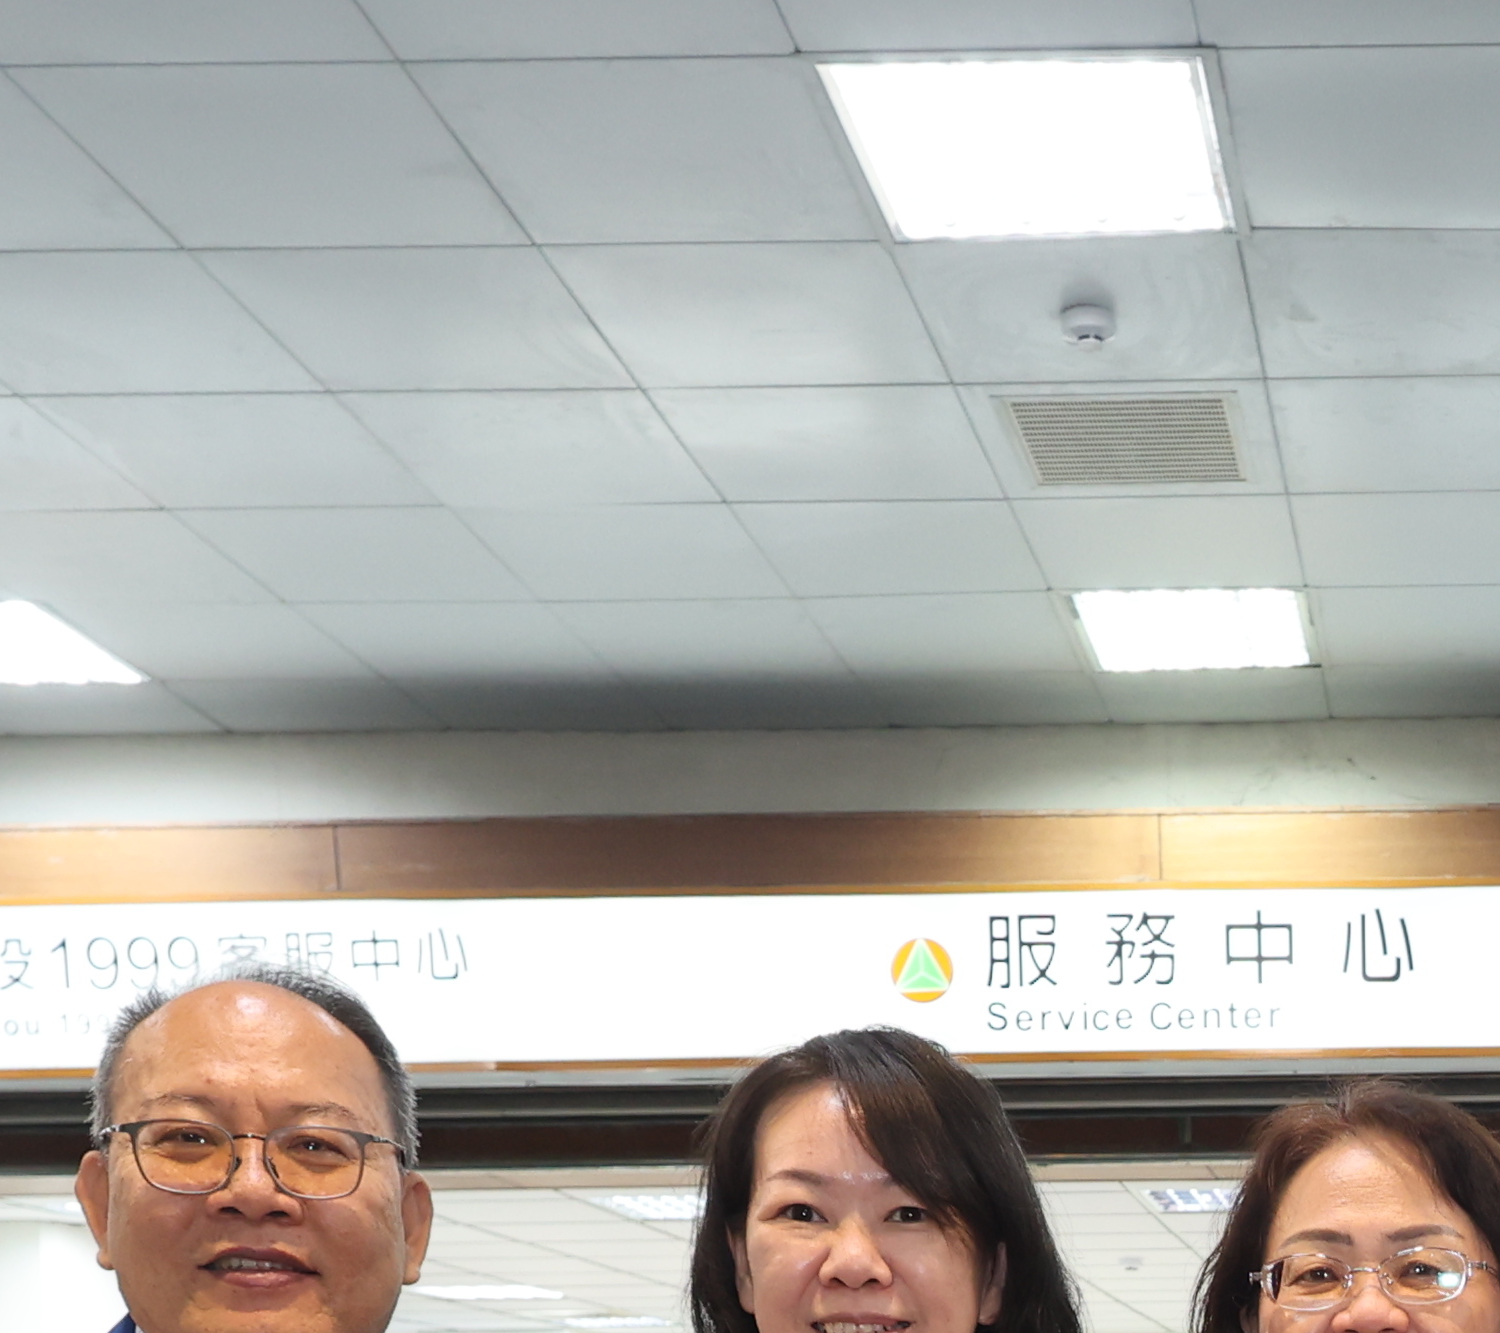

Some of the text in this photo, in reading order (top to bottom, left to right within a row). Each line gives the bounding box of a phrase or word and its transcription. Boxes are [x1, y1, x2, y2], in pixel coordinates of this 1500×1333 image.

[988, 908, 1414, 988] 服務中心
[987, 1001, 1280, 1032] Service Center
